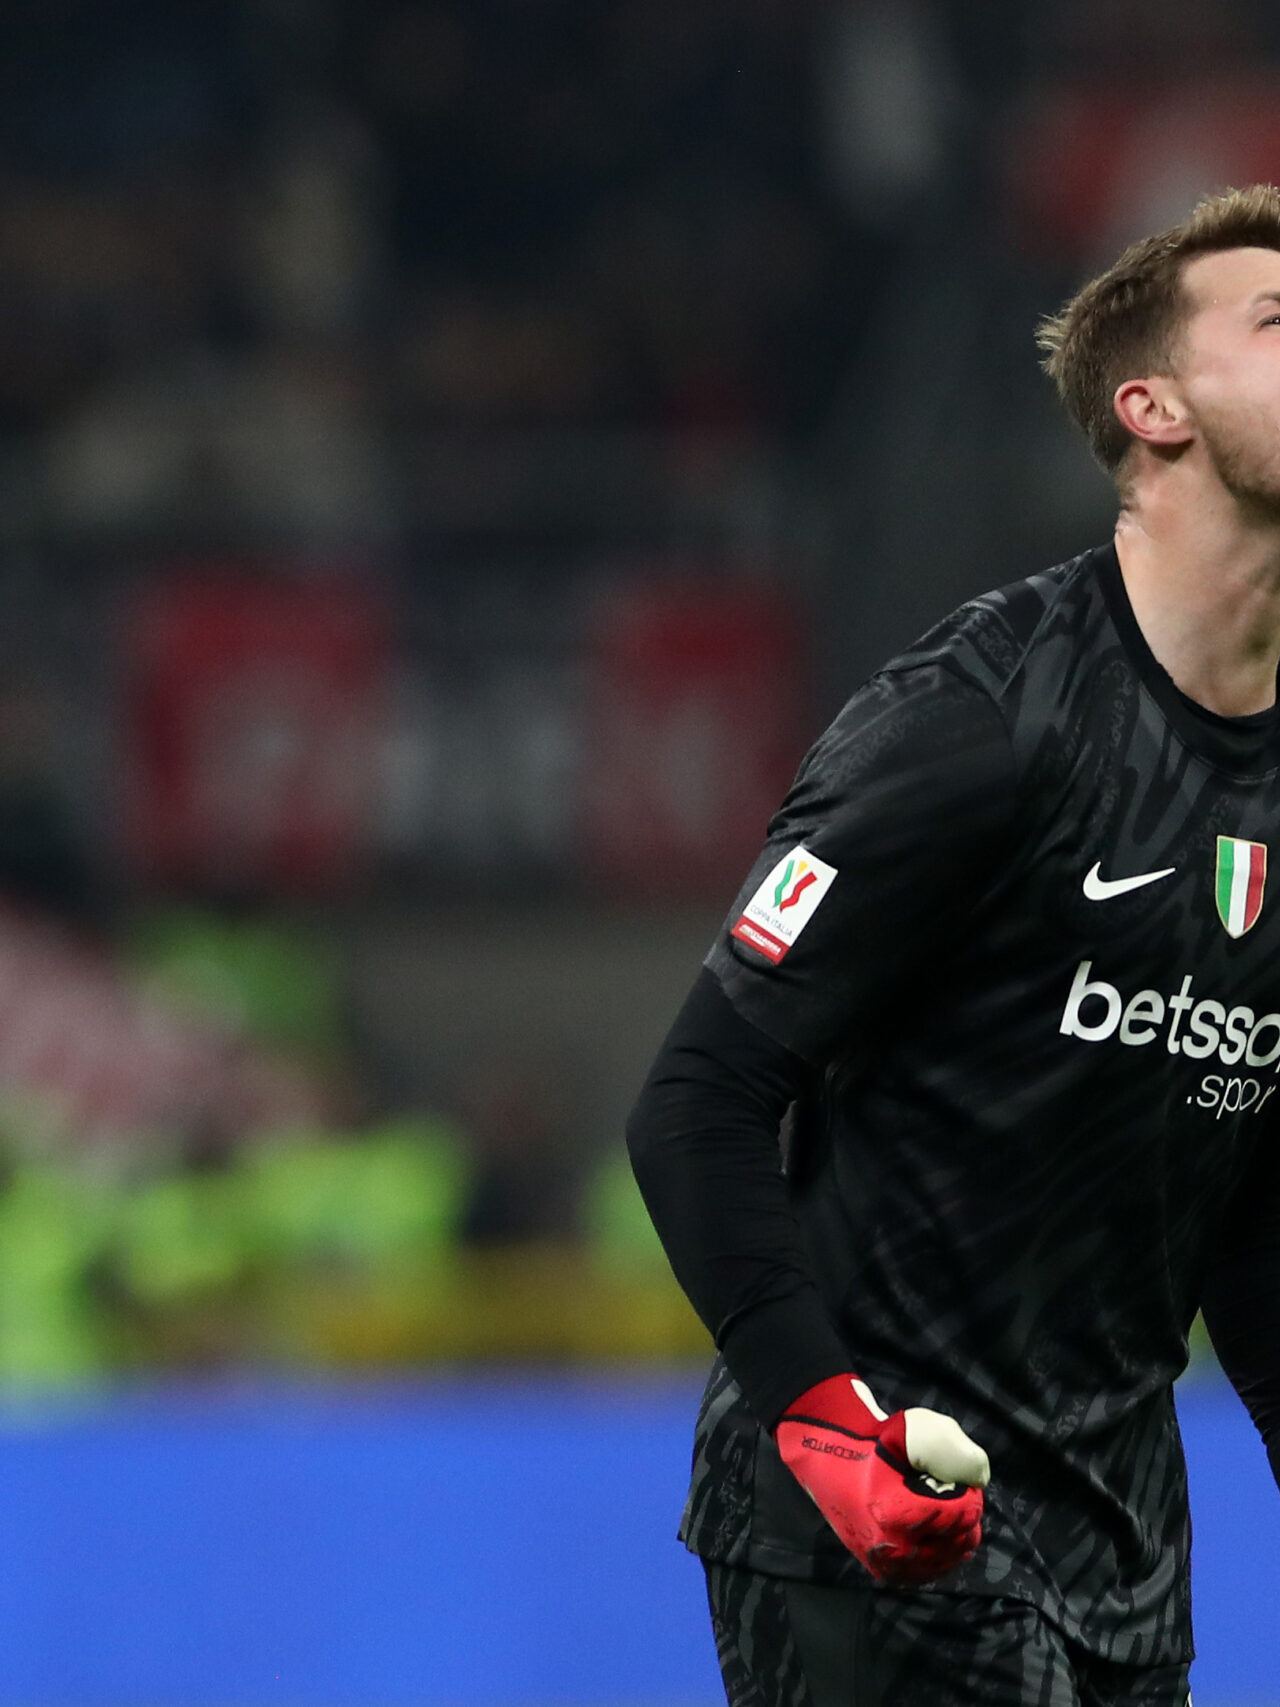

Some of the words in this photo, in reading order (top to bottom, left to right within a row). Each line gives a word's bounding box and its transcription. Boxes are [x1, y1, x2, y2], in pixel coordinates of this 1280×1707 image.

[751, 905, 770, 921] COPPA
[770, 919, 793, 937] ITALIA
[1186, 1075, 1276, 1119] .spor
